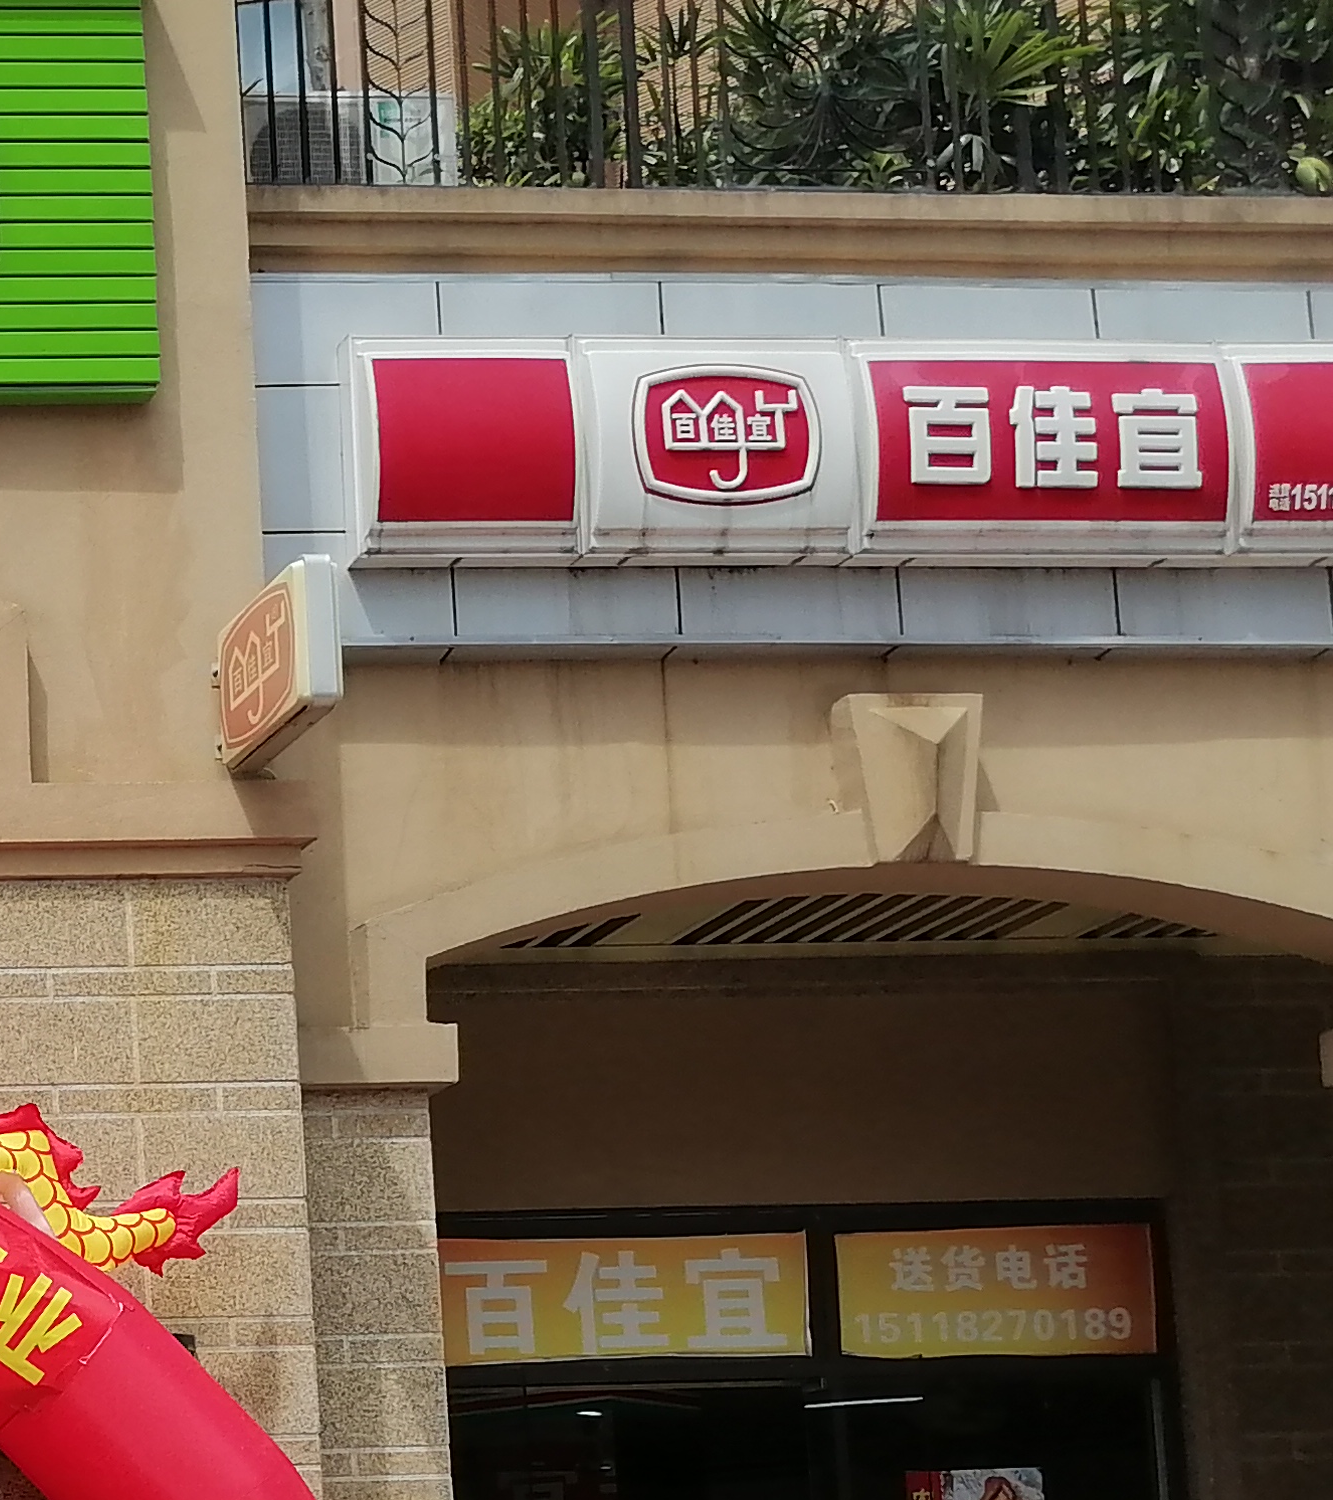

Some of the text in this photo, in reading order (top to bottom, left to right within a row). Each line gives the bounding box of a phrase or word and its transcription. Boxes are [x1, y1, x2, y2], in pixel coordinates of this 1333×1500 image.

[672, 412, 772, 441] 百佳宜
[903, 385, 1201, 489] 百佳宜
[889, 1244, 1089, 1293] 送货电话
[445, 1247, 789, 1356] 百佳宜
[853, 1305, 1132, 1346] 15118270189
